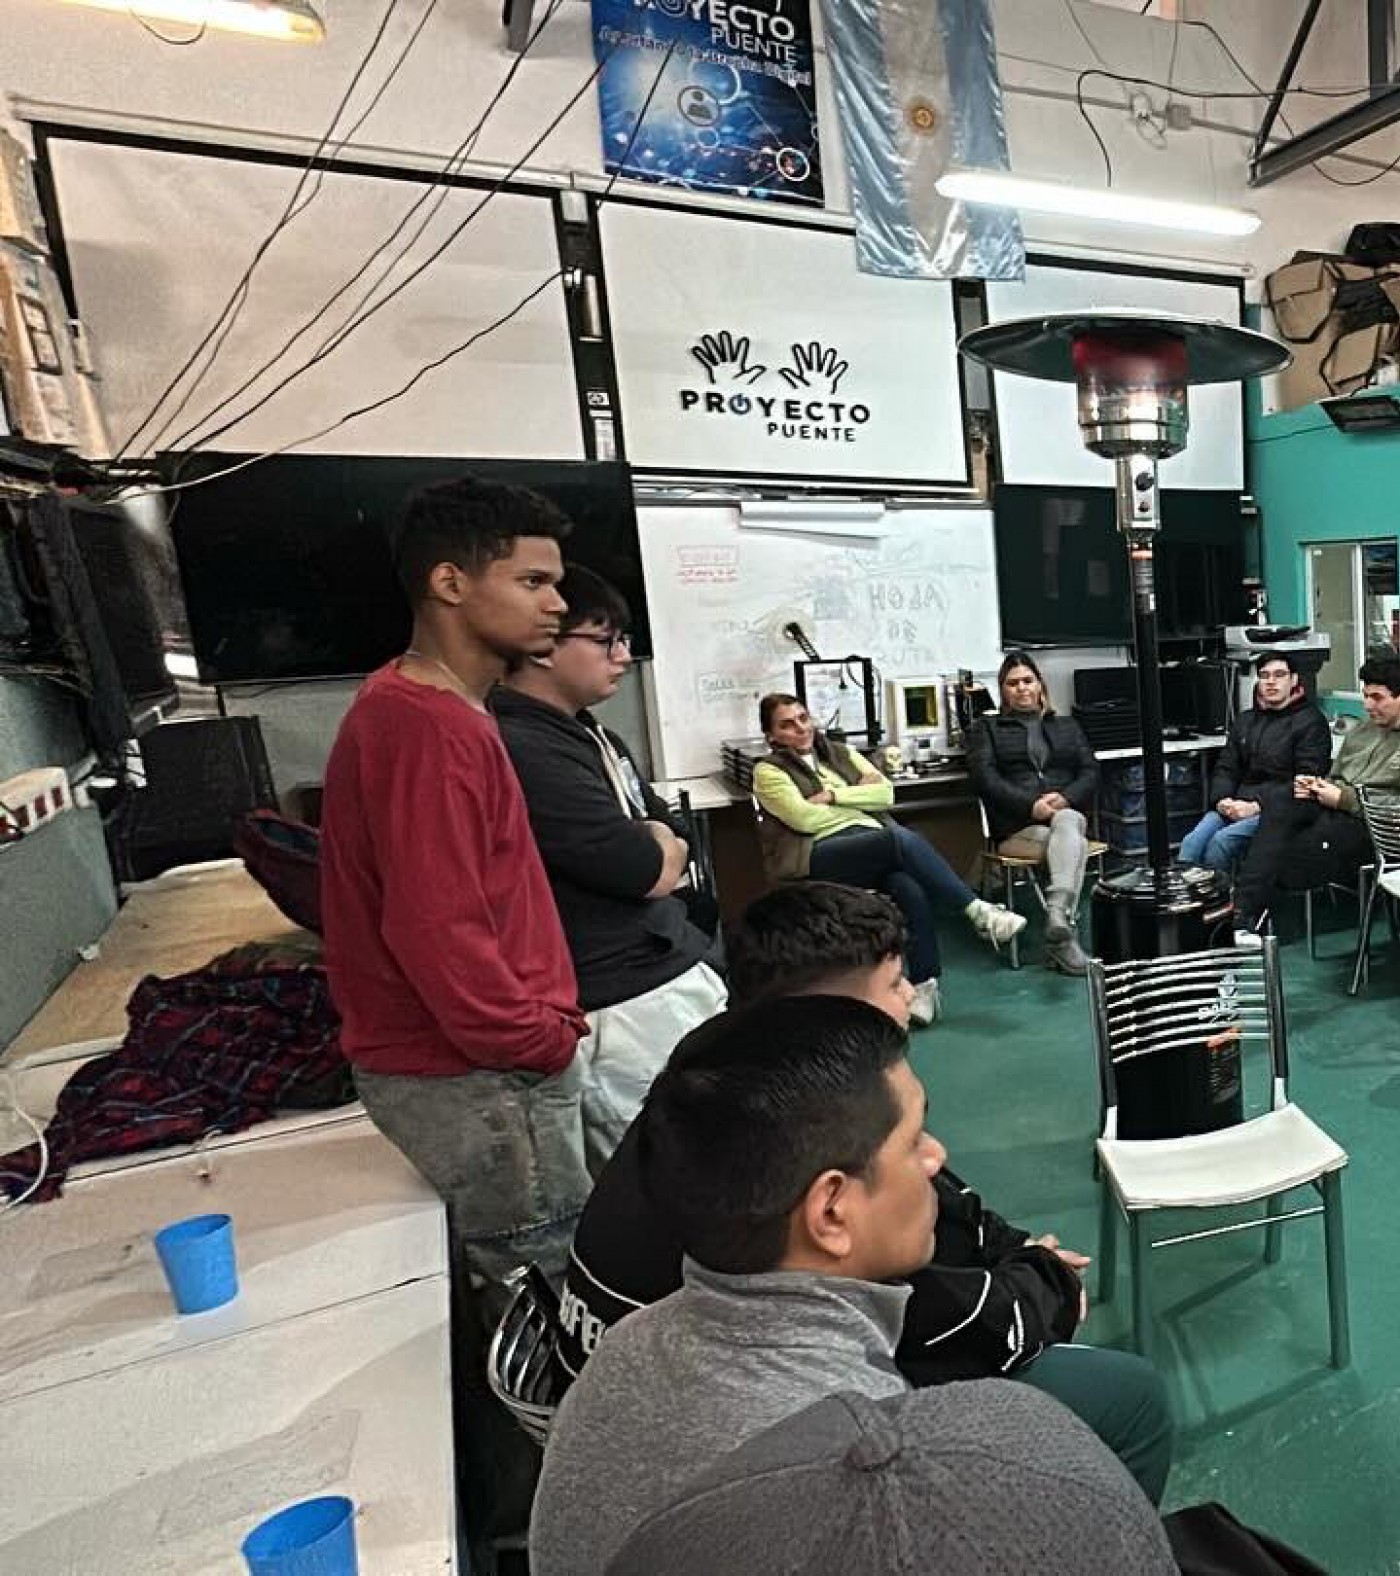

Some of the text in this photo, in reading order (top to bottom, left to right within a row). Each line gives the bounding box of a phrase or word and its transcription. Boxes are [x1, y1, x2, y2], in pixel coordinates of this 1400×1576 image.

[633, 0, 796, 42] OYECTO
[711, 25, 798, 64] PUENTE
[680, 389, 871, 425] PROYECTO
[767, 421, 857, 443] PUENTE
